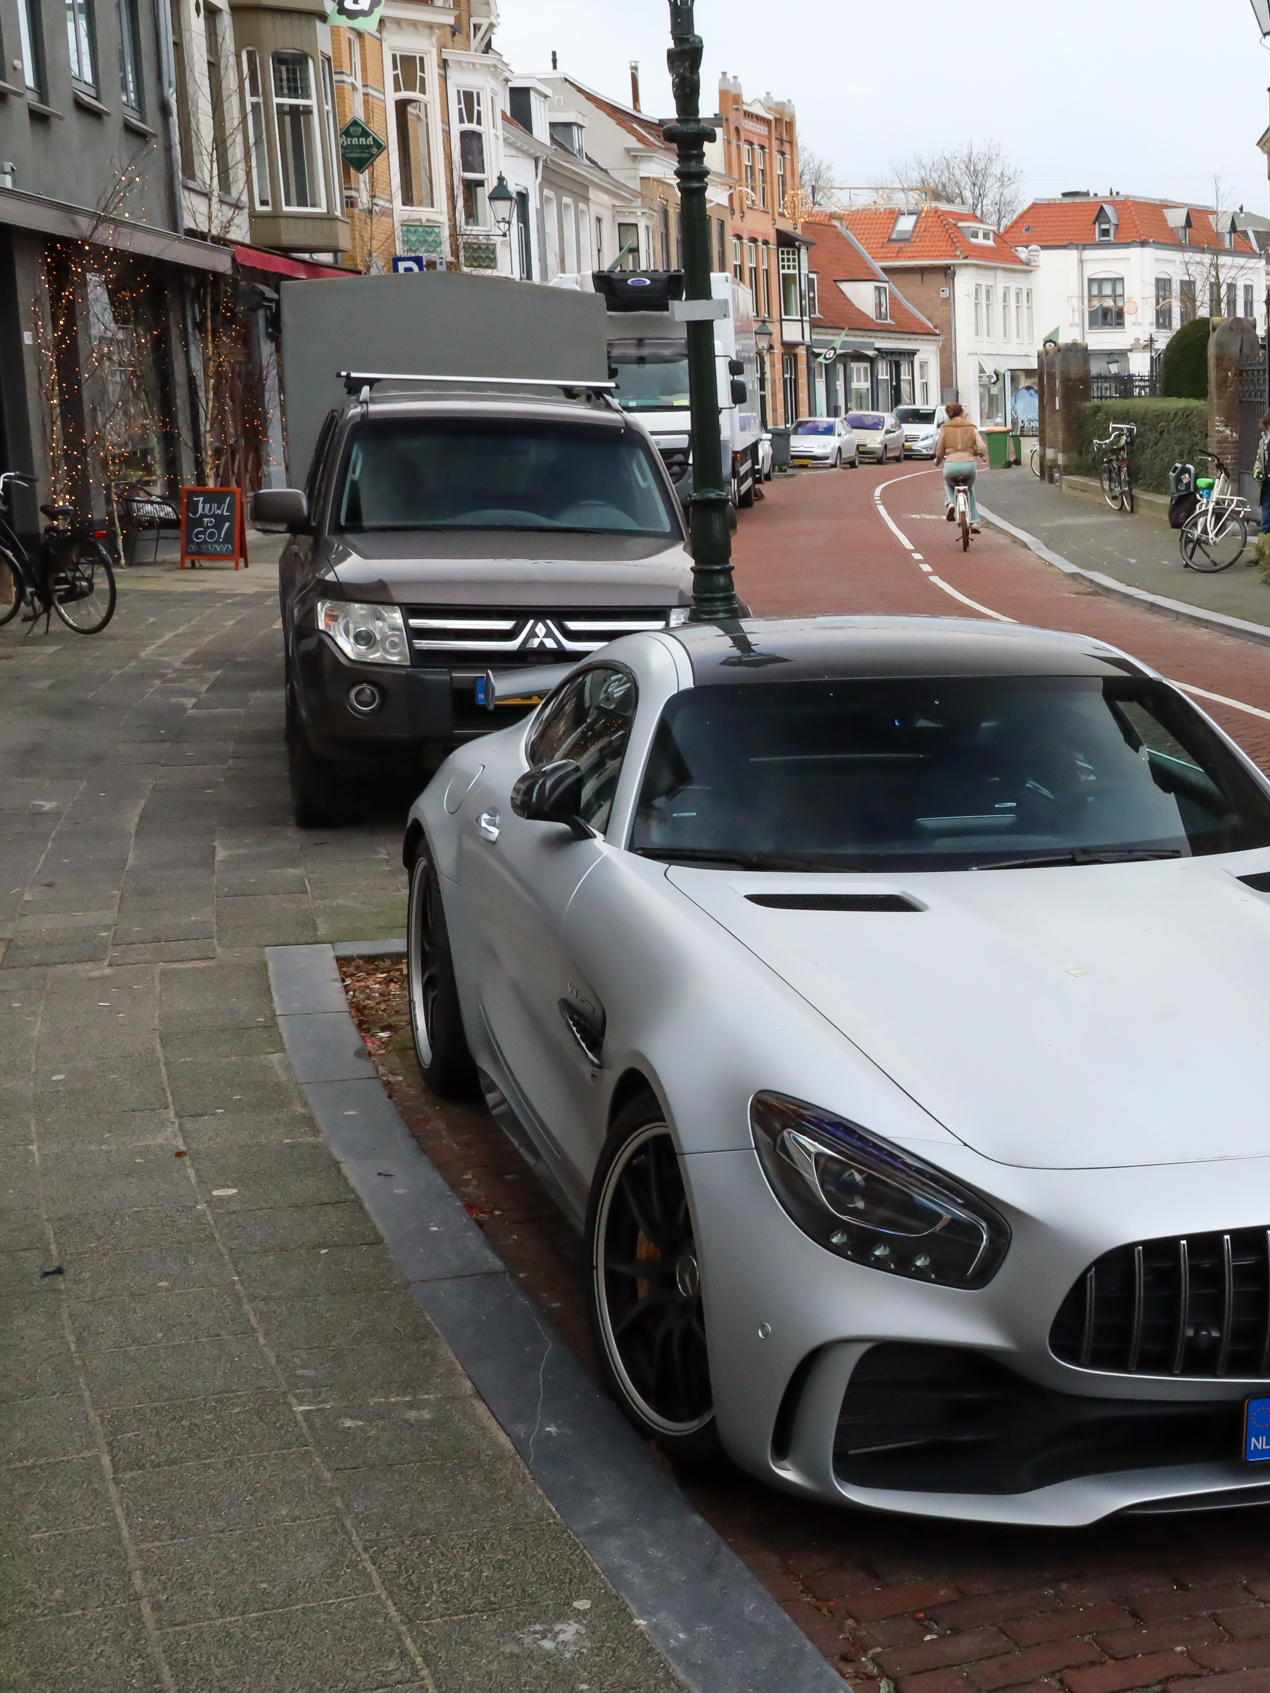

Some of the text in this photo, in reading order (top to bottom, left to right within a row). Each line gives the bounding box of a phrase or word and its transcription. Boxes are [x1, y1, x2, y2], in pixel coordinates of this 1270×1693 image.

[340, 134, 374, 147] Brand
[203, 517, 215, 527] TO
[192, 522, 231, 543] GO!
[1250, 1436, 1270, 1451] NL
